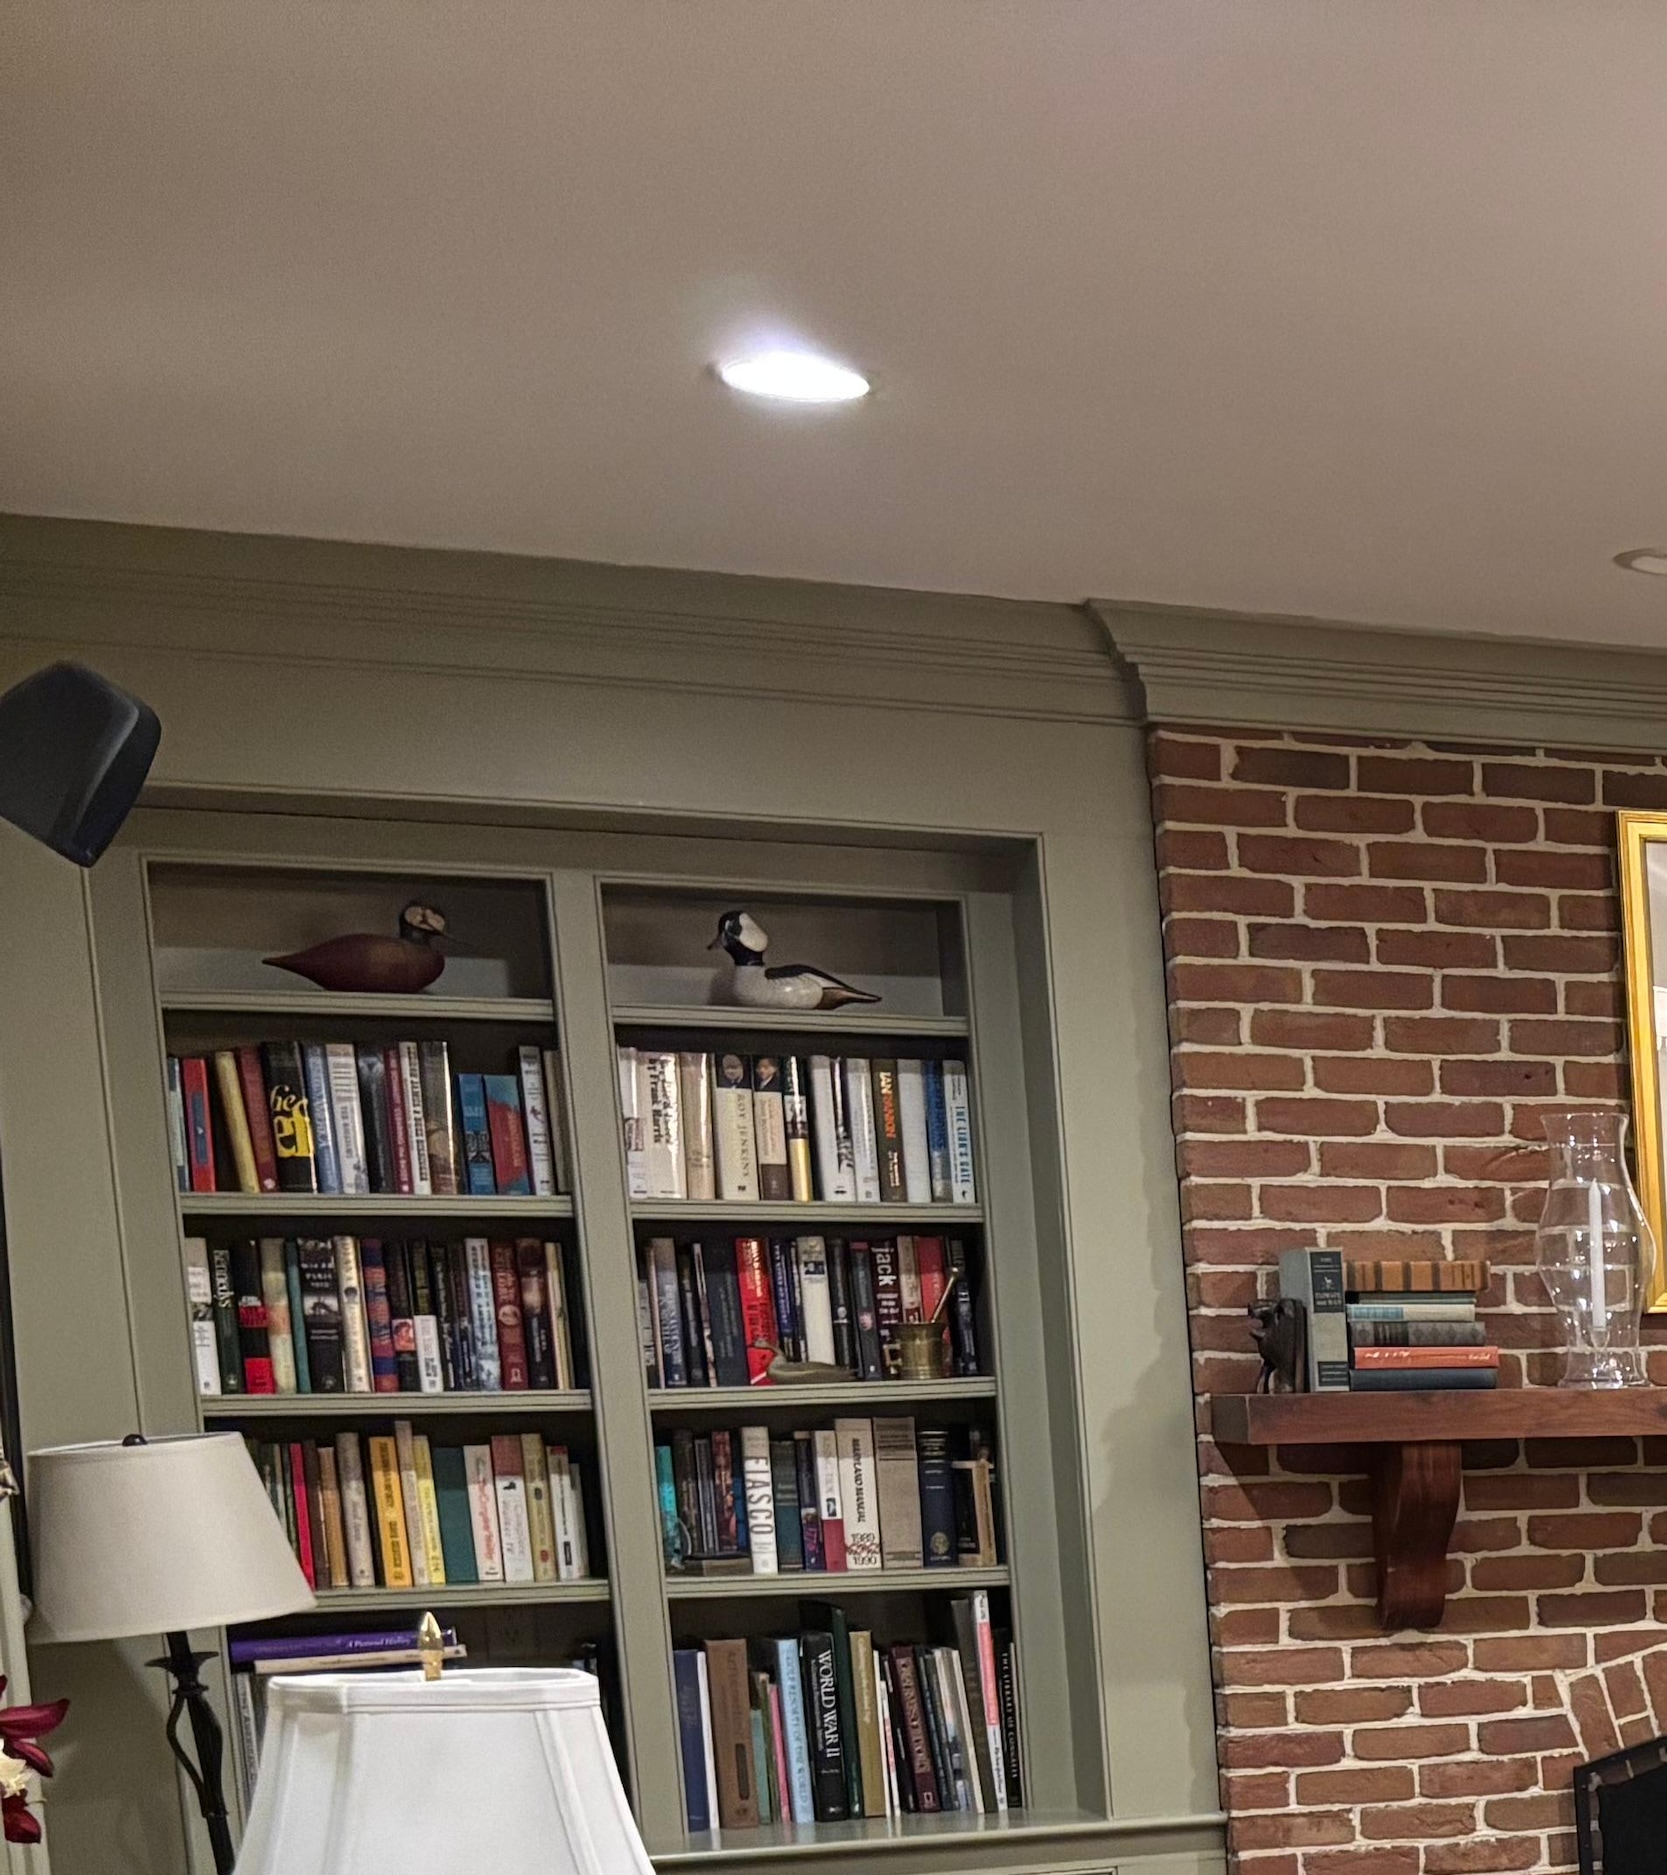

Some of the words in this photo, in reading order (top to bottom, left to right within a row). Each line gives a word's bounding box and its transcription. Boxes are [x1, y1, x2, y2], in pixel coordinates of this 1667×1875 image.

[212, 1249, 235, 1308] Kennedys
[872, 1247, 897, 1286] jack
[744, 1456, 774, 1535] FIASCO
[817, 1650, 836, 1708] WORLD
[823, 1709, 839, 1745] WAR
[825, 1747, 841, 1758] II
